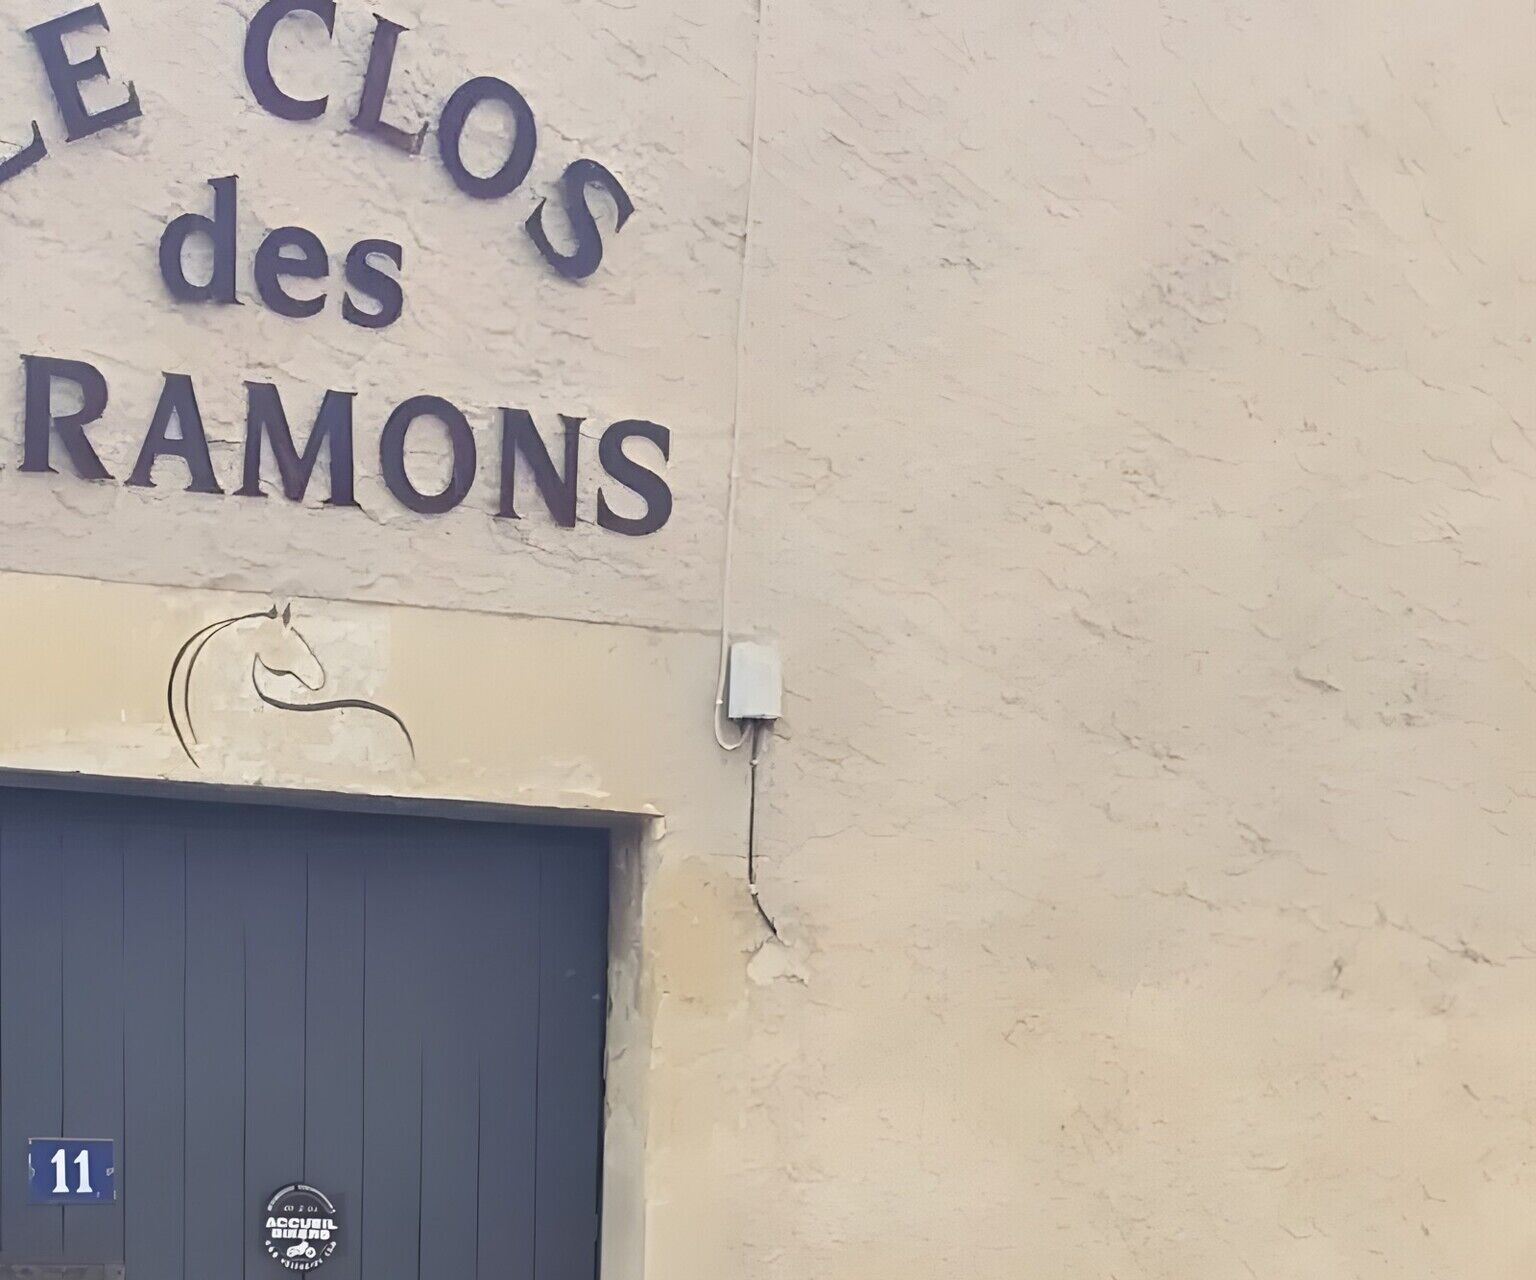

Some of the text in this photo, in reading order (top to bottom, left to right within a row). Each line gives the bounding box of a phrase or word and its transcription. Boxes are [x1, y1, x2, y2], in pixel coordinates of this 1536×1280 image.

[243, 0, 636, 280] CLOS
[159, 174, 404, 329] des
[50, 1148, 94, 1194] 11
